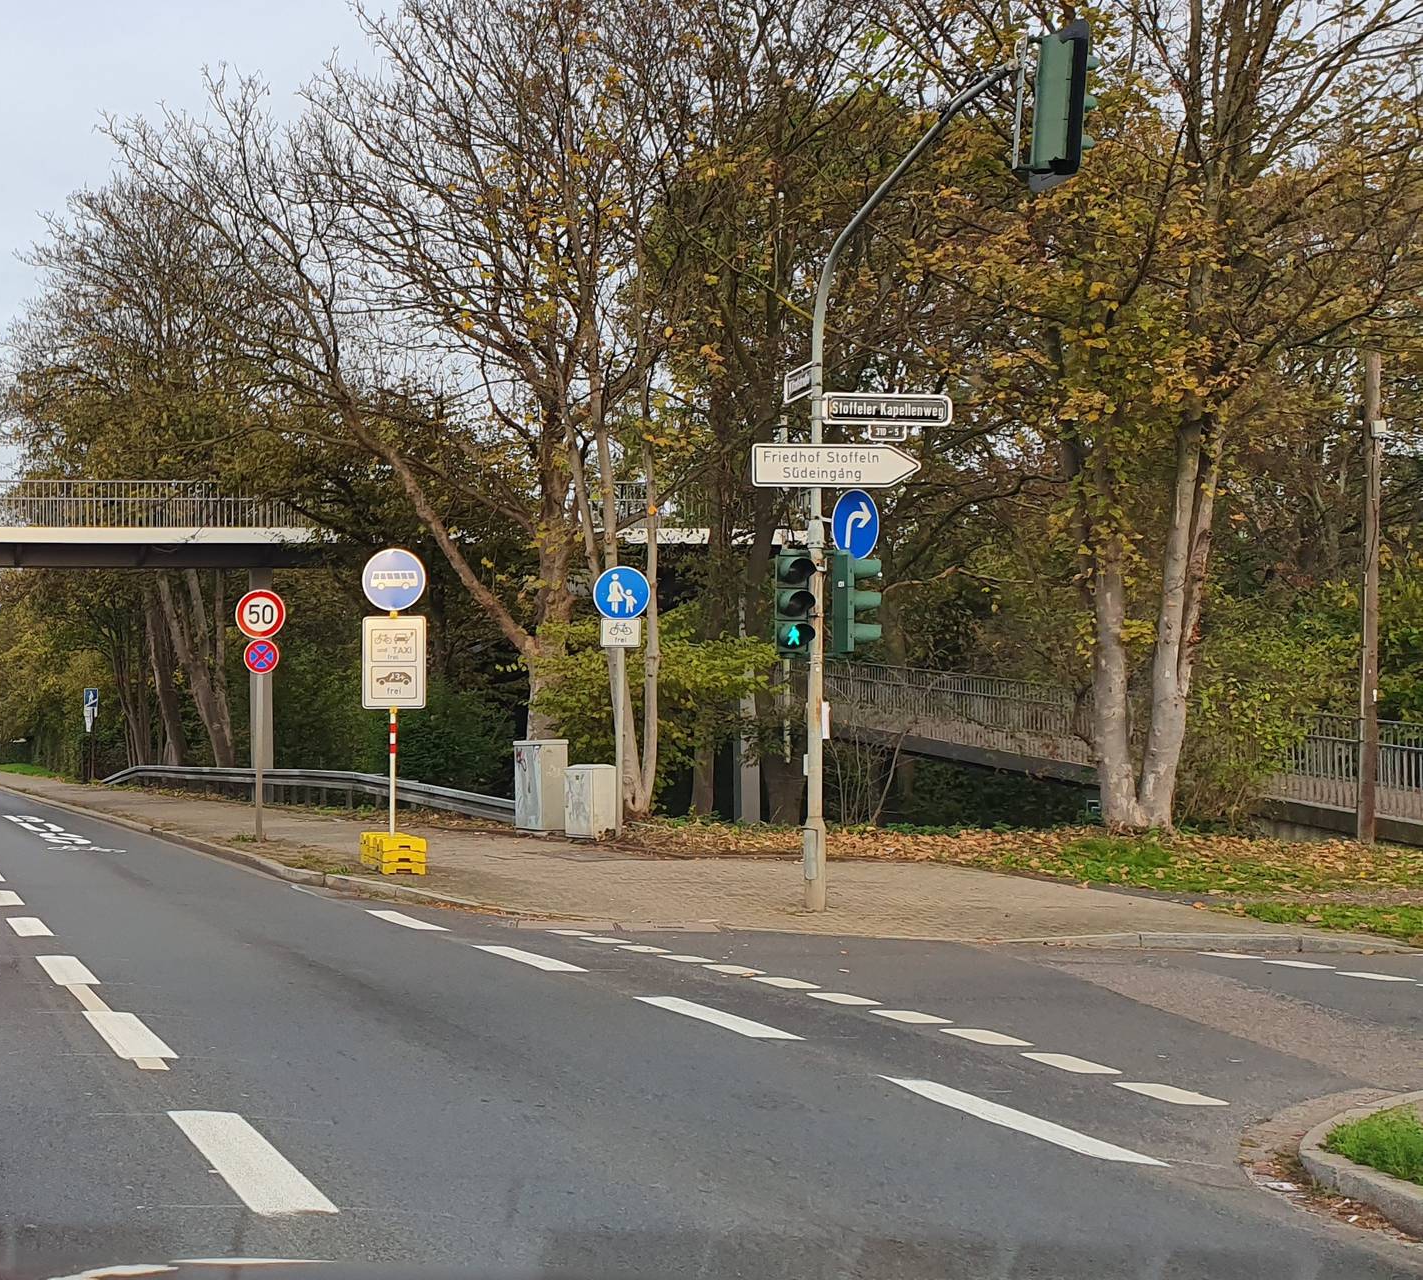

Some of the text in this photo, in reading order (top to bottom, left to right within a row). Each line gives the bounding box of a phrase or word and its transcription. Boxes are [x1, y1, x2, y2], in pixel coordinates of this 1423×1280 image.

[832, 401, 945, 418] Stoffeler Kapellenweg
[763, 451, 880, 463] Friedhof Stoffeln
[782, 467, 862, 481] Südeingang
[248, 604, 274, 625] 50
[392, 646, 413, 654] TAXI
[387, 687, 402, 695] frei
[1, 814, 92, 845] BUS
